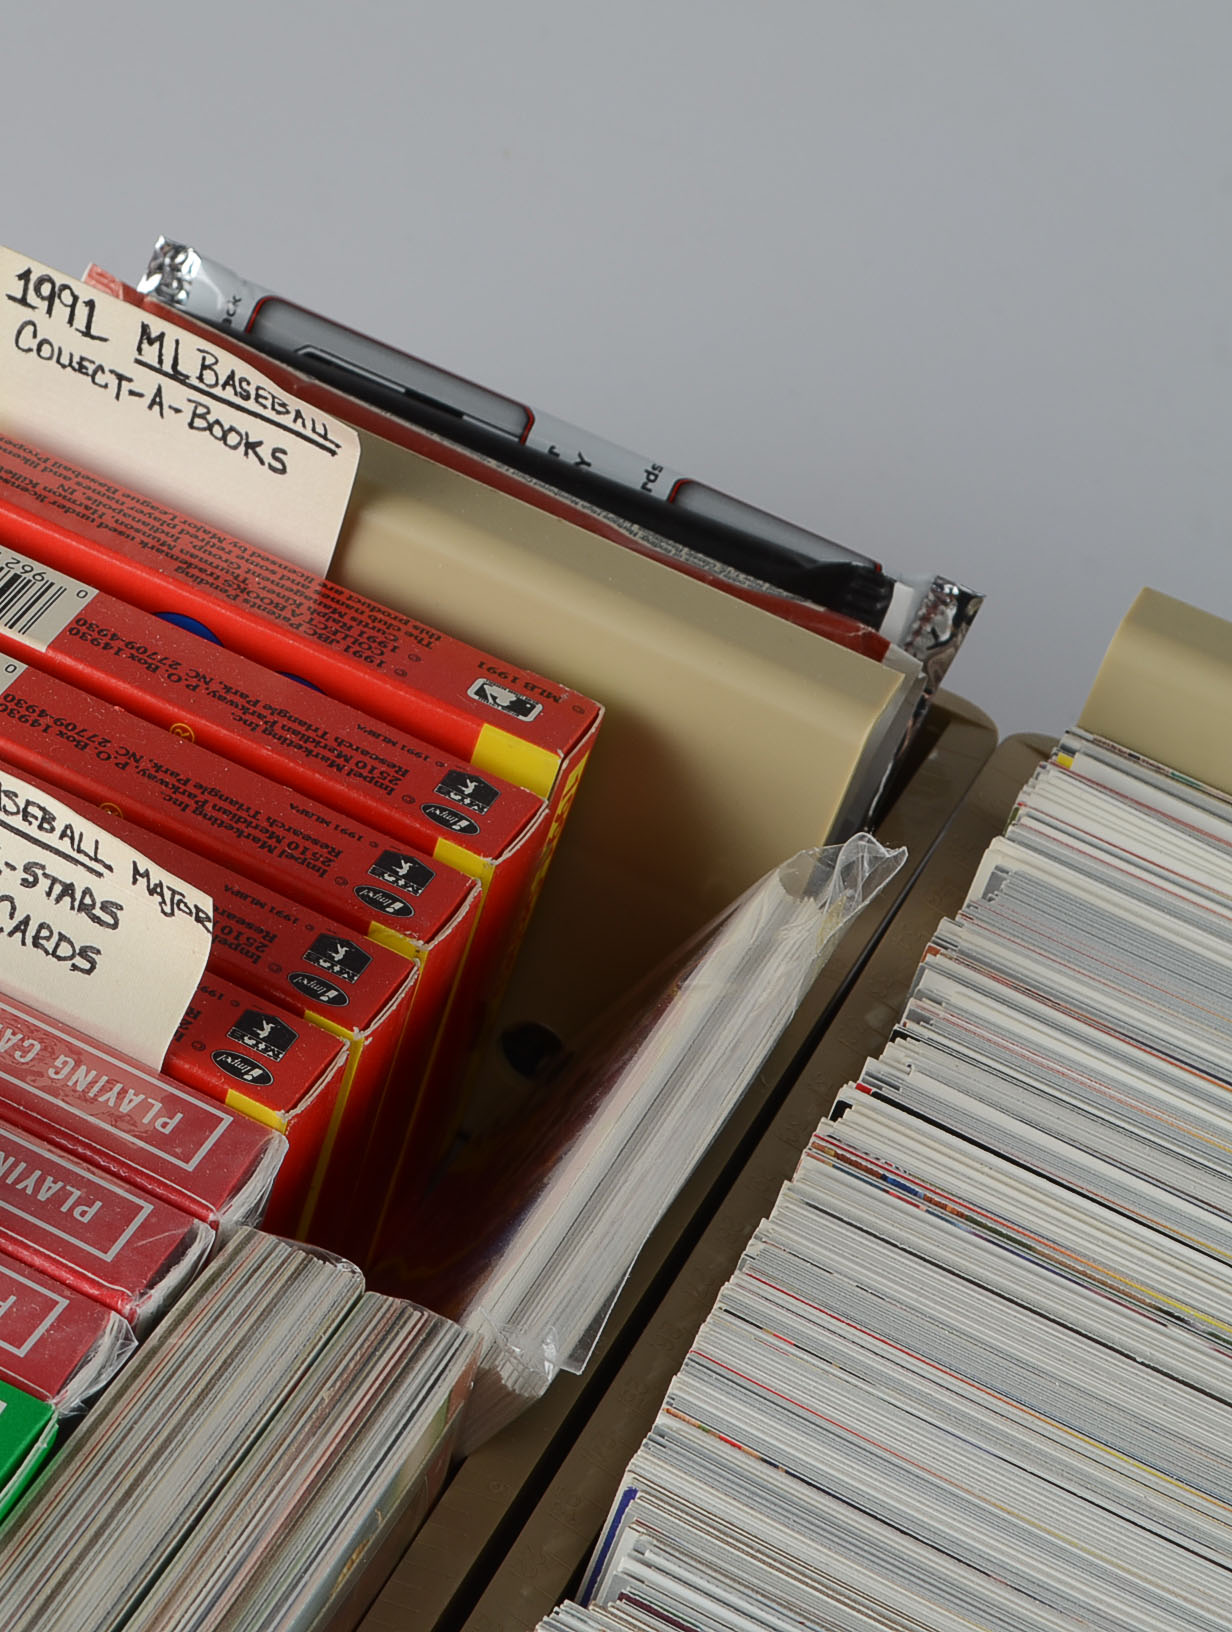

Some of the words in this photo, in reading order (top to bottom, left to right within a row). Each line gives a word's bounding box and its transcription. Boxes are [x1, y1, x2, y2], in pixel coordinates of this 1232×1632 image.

[6, 267, 108, 341] 1991
[42, 486, 106, 519] Harmon
[48, 501, 96, 523] under
[96, 522, 136, 541] used
[180, 548, 248, 586] Thurman
[174, 566, 240, 600] Pending
[222, 580, 288, 611] BOOKS
[243, 598, 304, 630] Patents
[308, 606, 354, 632] Ralph
[68, 627, 123, 656] 14930
[76, 618, 182, 670] 27709-4930
[304, 628, 340, 645] JBC
[305, 618, 384, 656] COLLECT
[358, 630, 400, 653] 1991
[128, 653, 160, 672] Box
[344, 645, 386, 667] 1991
[165, 670, 200, 692] P.O.
[186, 669, 213, 686] NC
[478, 662, 519, 683] 1991
[219, 682, 260, 708] Park,
[524, 682, 561, 703] MLB
[4, 694, 110, 748] 27709-4930
[205, 687, 278, 730] Parkway,
[232, 712, 260, 732] Inc.
[263, 704, 328, 741] Triangle
[56, 730, 90, 751] Box
[262, 726, 346, 772] Marketing
[281, 724, 354, 764] Meridian
[94, 747, 130, 770] P.O.
[115, 746, 144, 764] NC
[334, 736, 410, 777] Research
[149, 759, 192, 786] Park,
[346, 768, 396, 796] Impel
[355, 760, 402, 786] 2510
[135, 766, 209, 809] Parkway,
[194, 782, 261, 821] Triangle
[160, 792, 190, 812] Inc.
[192, 806, 278, 854] Marketing
[213, 804, 286, 844] Meridian
[266, 816, 343, 859] Research
[278, 850, 328, 878] Impel
[287, 841, 335, 867] 2510
[132, 859, 213, 935] MAJOR
[48, 1054, 183, 1134] PLAYING
